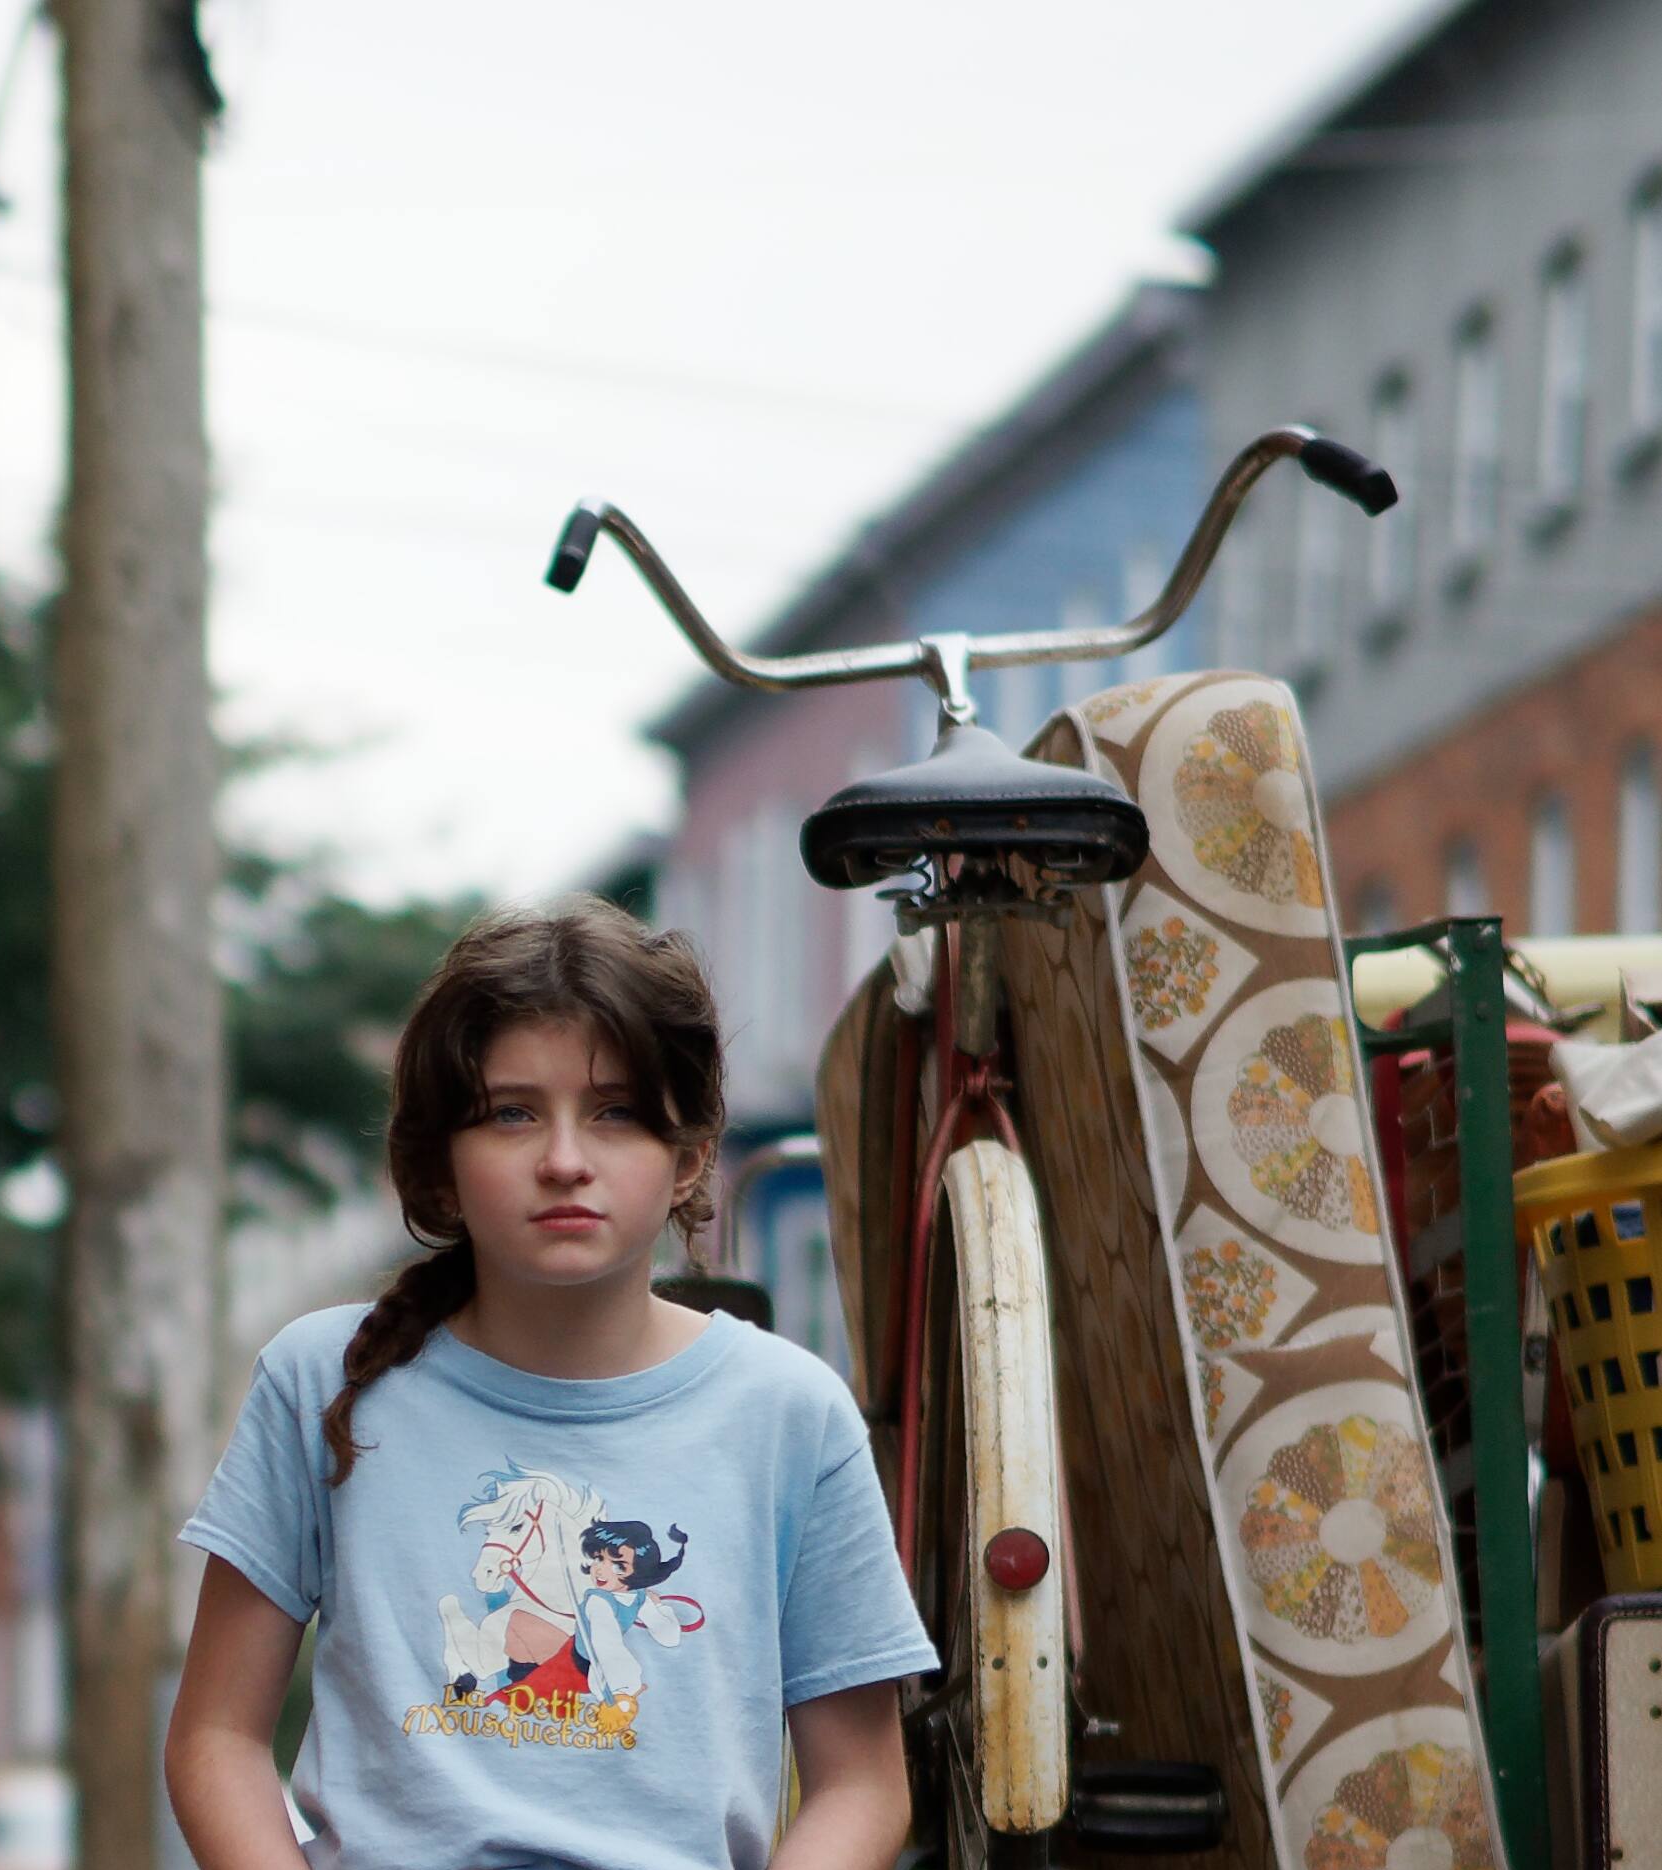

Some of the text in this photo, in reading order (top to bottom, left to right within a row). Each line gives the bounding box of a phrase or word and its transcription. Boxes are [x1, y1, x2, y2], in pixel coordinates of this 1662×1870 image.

[401, 1703, 637, 1750] Mousquetaire
[442, 1683, 600, 1728] La Petite
